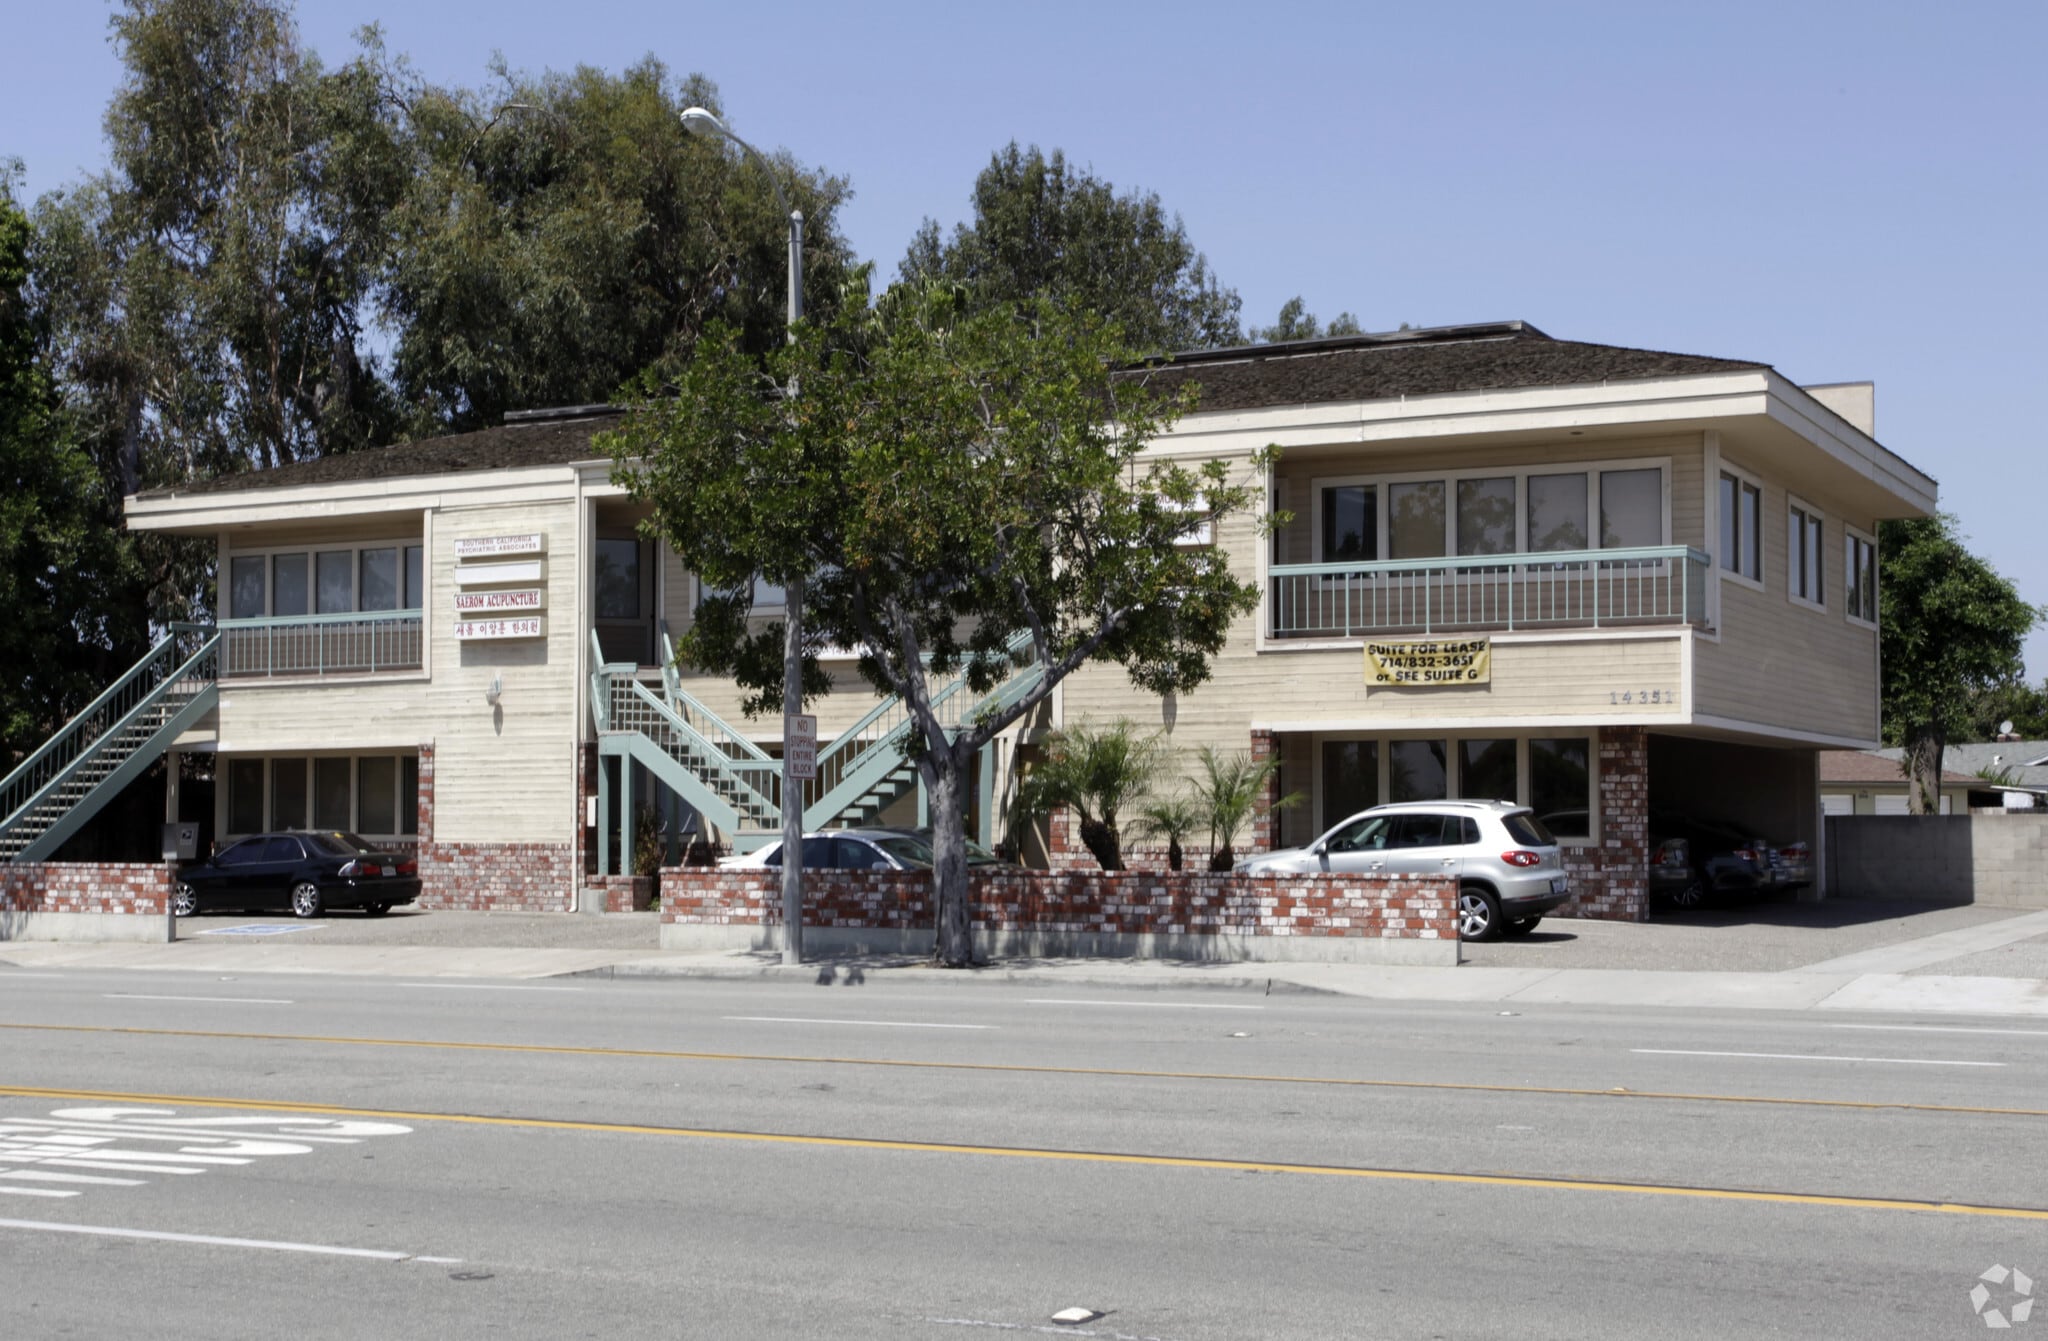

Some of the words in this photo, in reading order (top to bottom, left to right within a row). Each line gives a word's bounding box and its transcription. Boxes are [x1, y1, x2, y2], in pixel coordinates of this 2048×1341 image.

[462, 538, 494, 547] SOUTHERN
[496, 535, 533, 545] CALIFORNIA
[457, 545, 497, 554] PSYCHIATRIC
[499, 542, 537, 551] ASSOCIATES
[455, 594, 485, 609] SAEROM
[486, 591, 539, 607] ACUPUNCTURE
[1368, 644, 1406, 655] SUITE
[1410, 643, 1438, 654] FOR
[1443, 641, 1486, 654] LEASE
[1380, 655, 1475, 668] 714/832-3651
[1395, 671, 1419, 681] SEE
[1424, 670, 1463, 681] SUITE
[1468, 669, 1478, 679] G
[1610, 689, 1673, 705] 14351
[797, 719, 808, 732] NO
[790, 735, 815, 748] STOPPING
[792, 750, 812, 761] ENTIRE
[792, 763, 812, 774] BLOCK
